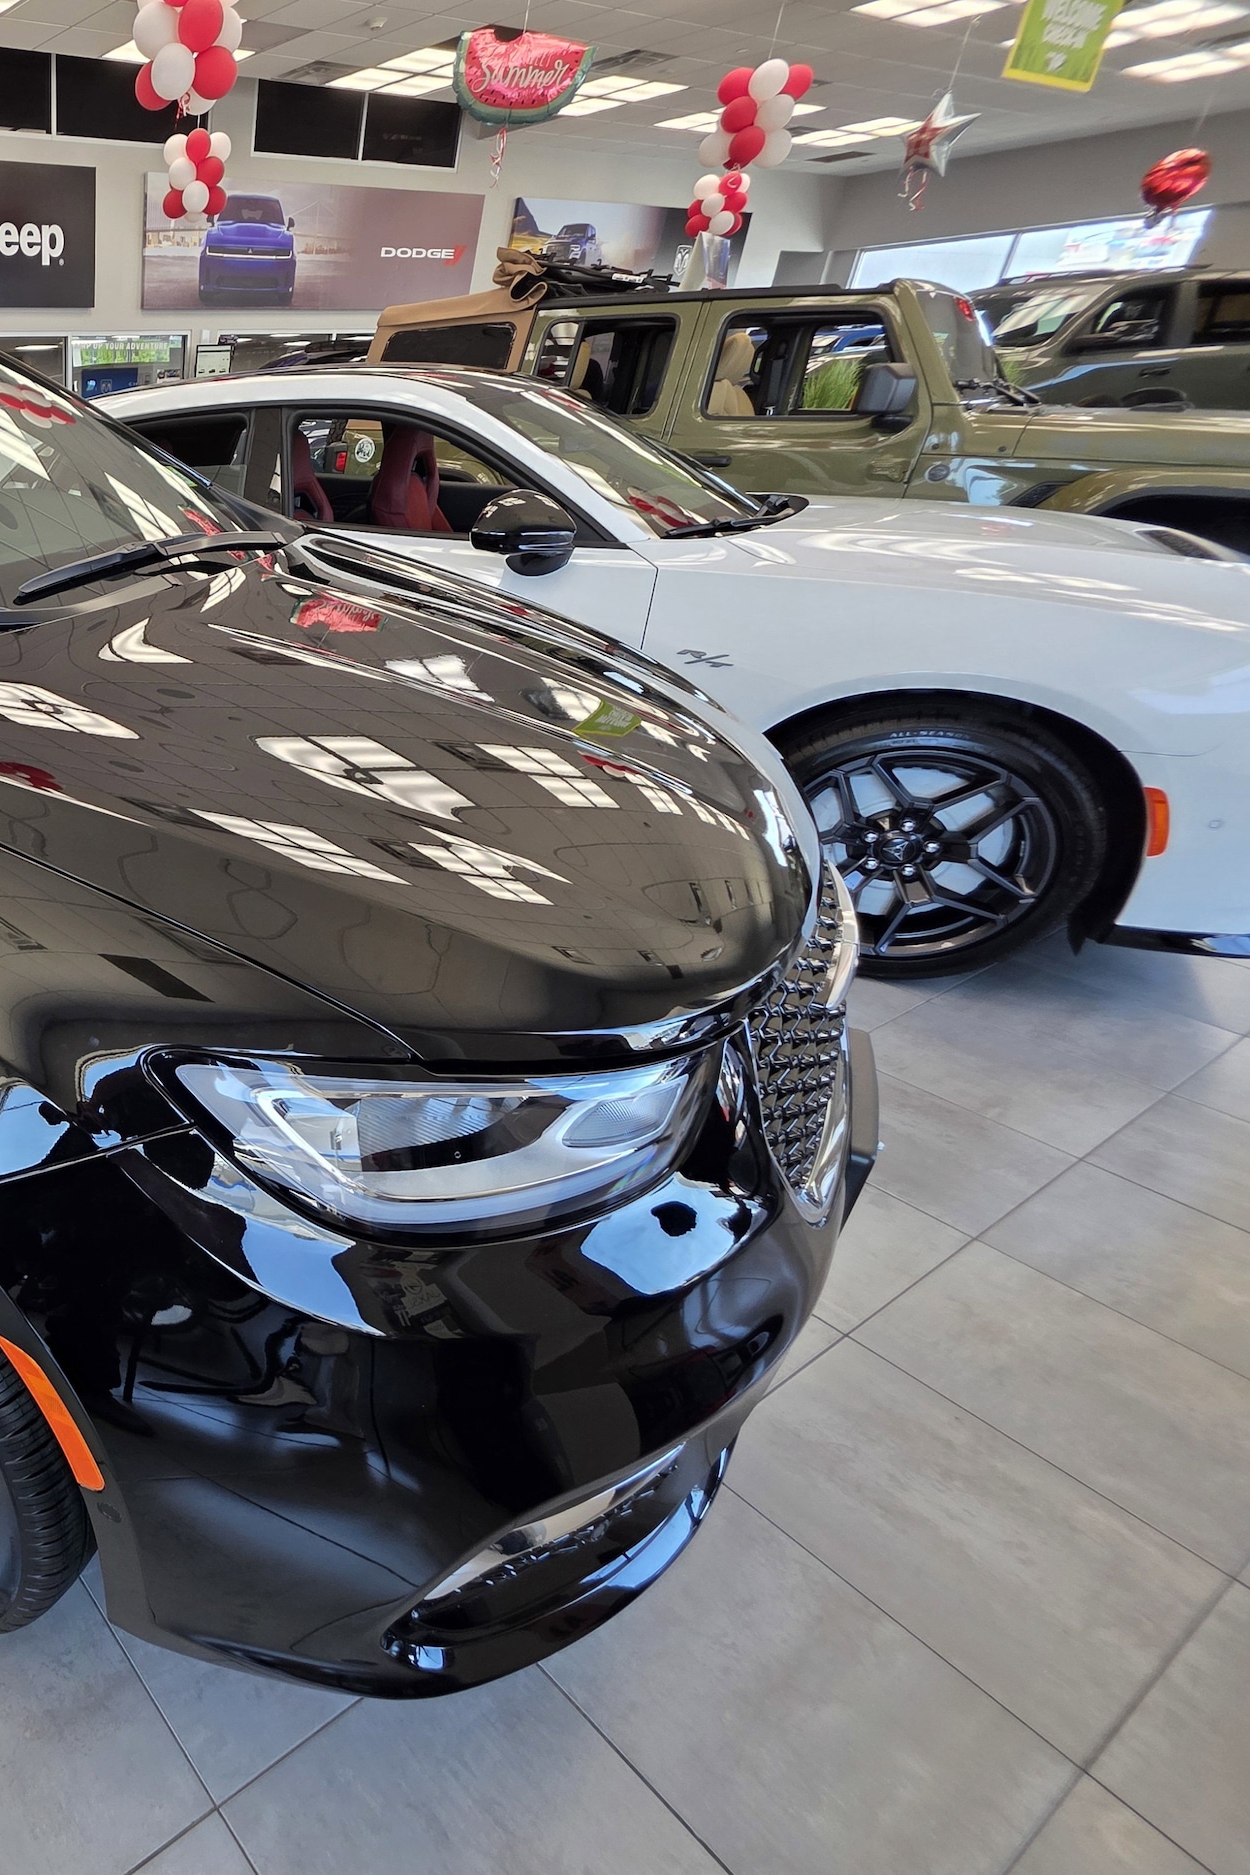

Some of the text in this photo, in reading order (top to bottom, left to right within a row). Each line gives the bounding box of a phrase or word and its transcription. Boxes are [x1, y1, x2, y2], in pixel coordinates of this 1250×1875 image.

[471, 59, 569, 92] Summer
[380, 246, 455, 259] DODGE
[105, 342, 124, 350] YOUR
[126, 342, 169, 350] ADVENTURE
